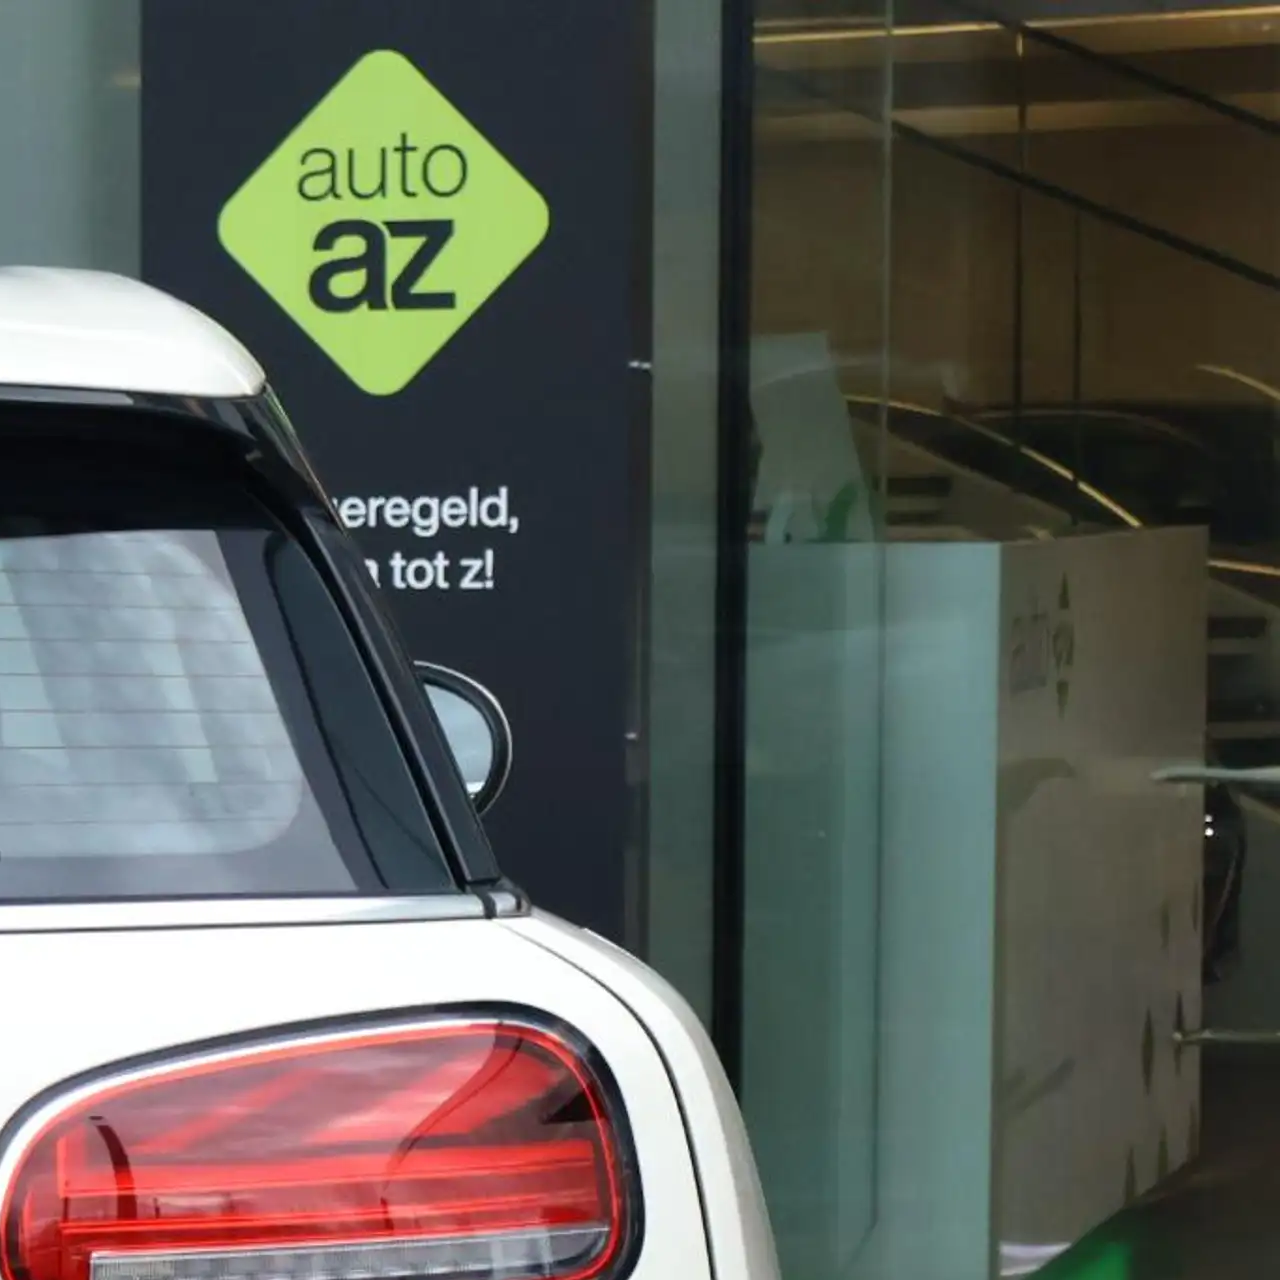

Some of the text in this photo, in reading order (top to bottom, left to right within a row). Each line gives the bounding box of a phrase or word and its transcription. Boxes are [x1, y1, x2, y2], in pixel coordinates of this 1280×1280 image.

[296, 132, 468, 200] auto
[308, 217, 456, 313] az
[333, 486, 519, 537] eregeld,
[389, 550, 450, 590] tot
[458, 548, 495, 590] z!
